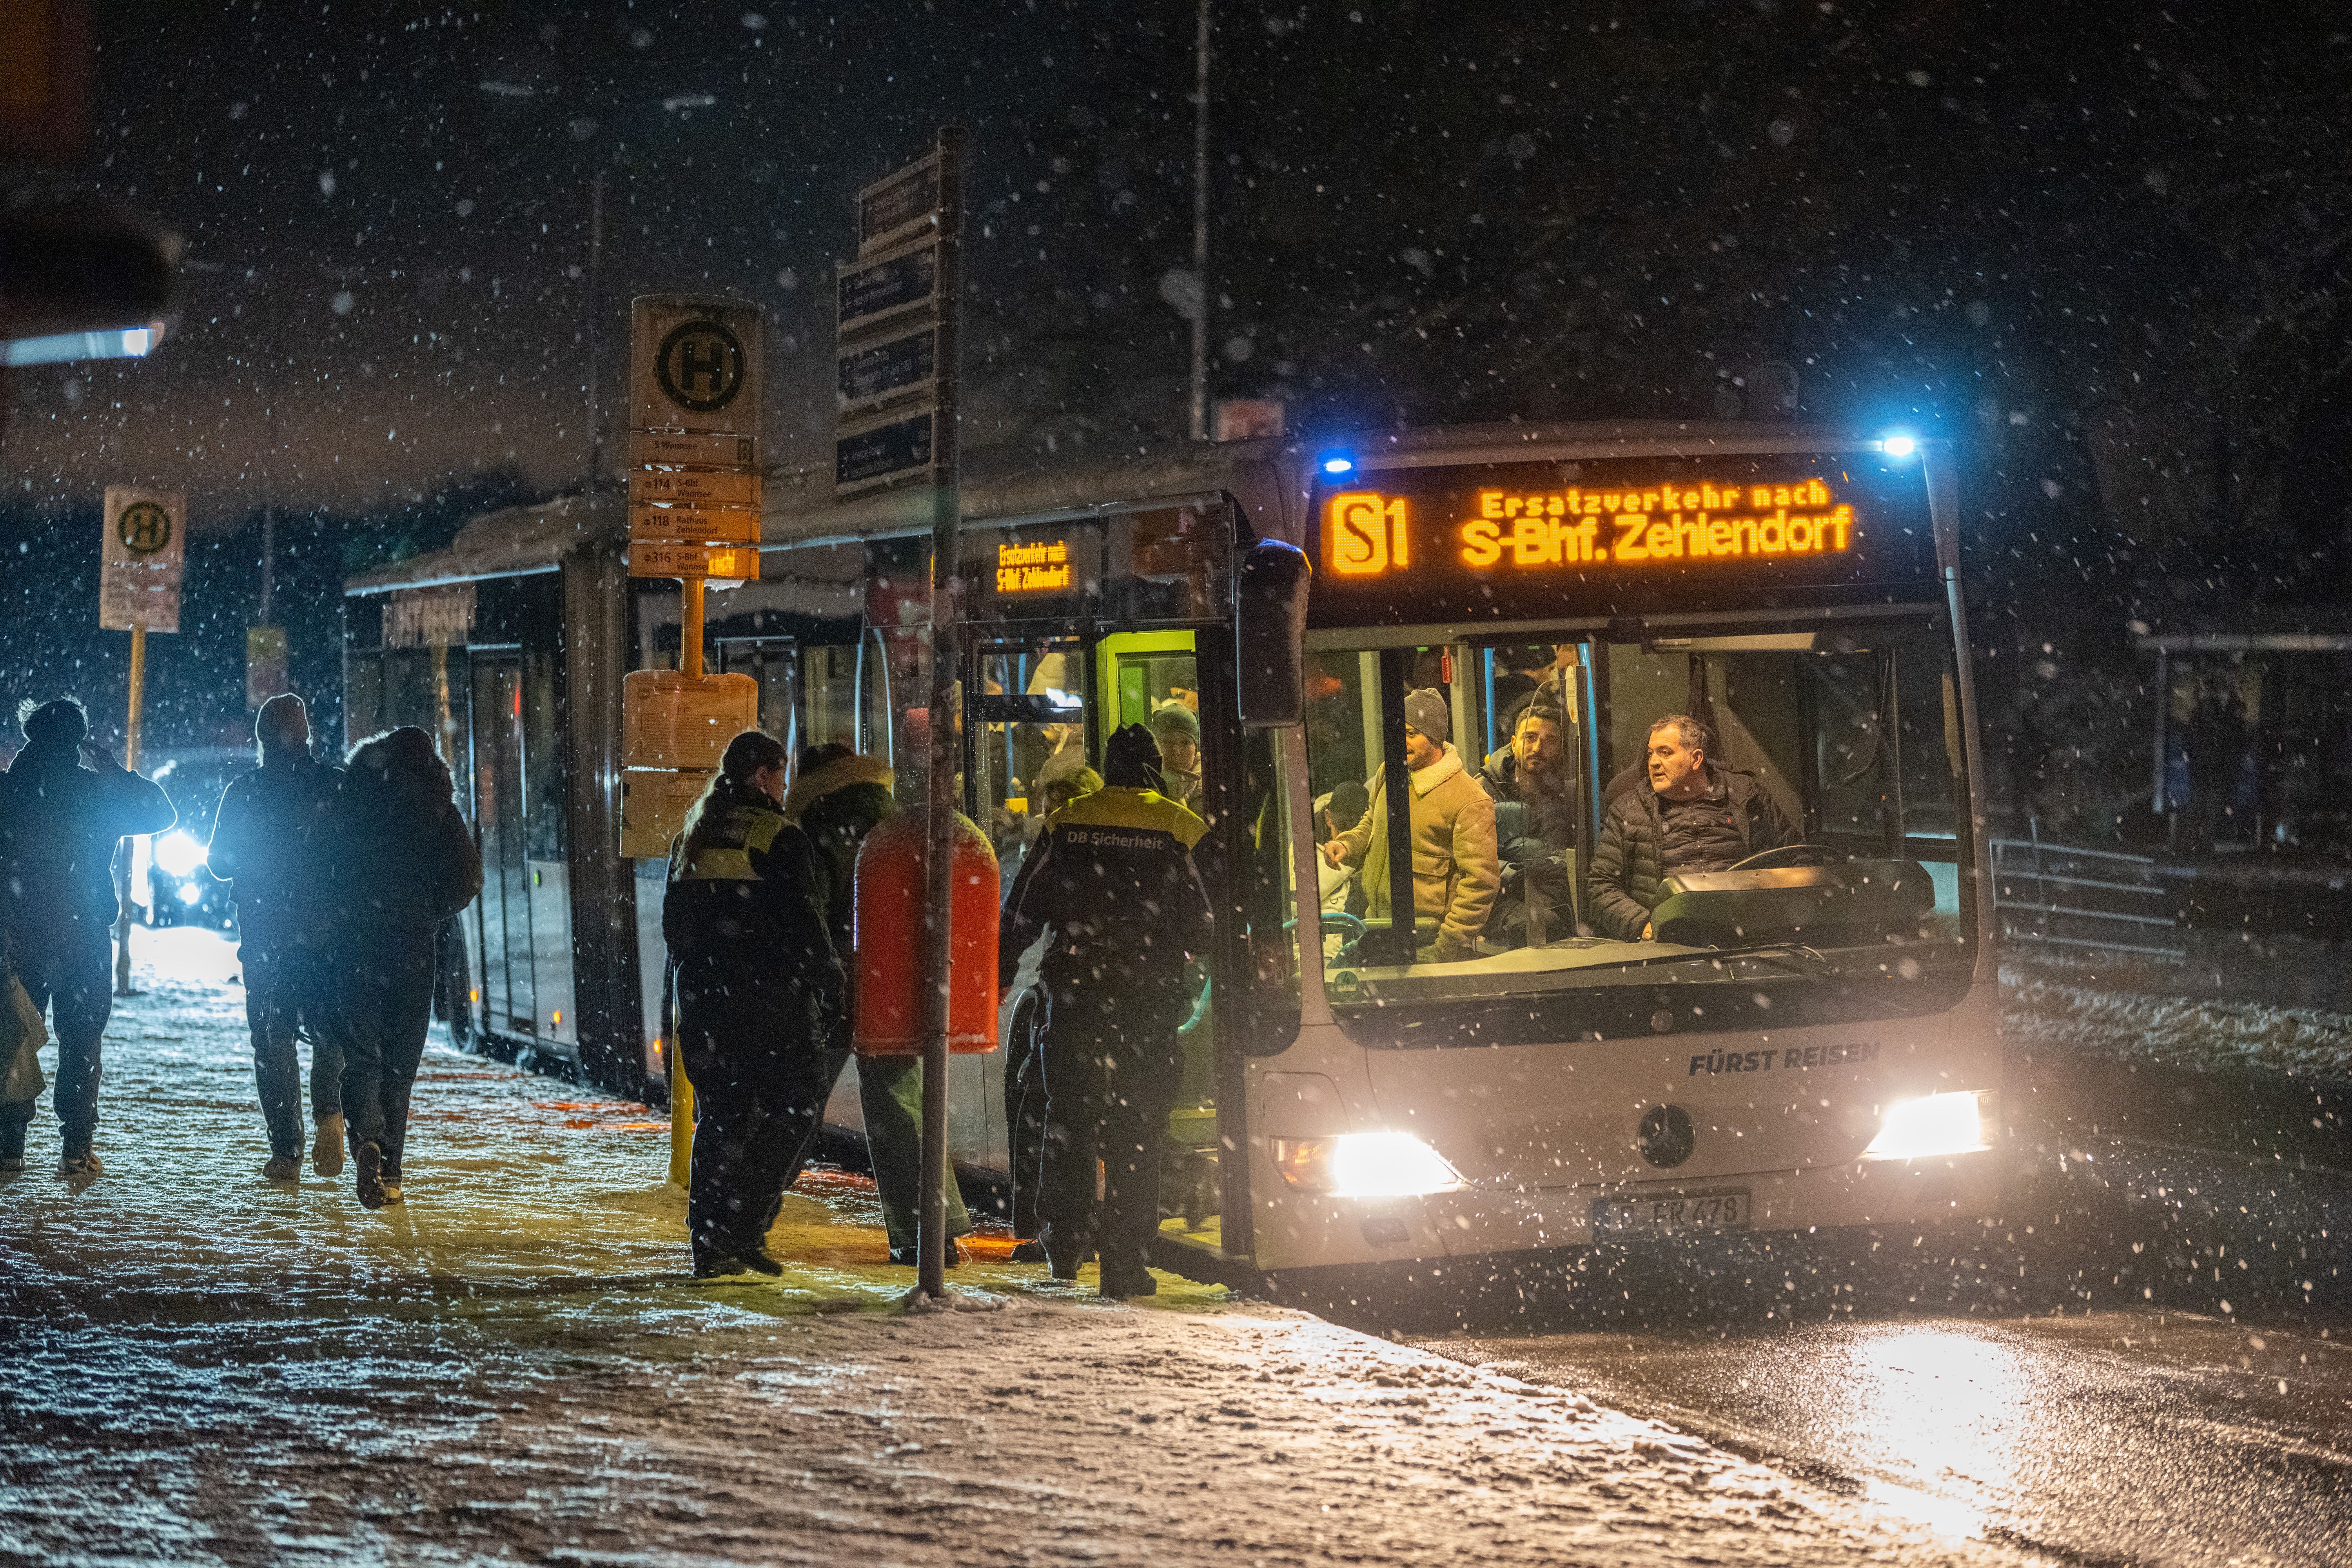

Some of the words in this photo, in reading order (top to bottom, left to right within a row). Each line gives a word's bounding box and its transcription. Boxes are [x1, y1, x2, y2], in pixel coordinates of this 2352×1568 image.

[682, 341, 722, 391] H
[662, 441, 697, 450] Wannsee
[653, 479, 670, 489] 114
[677, 489, 712, 498] Wannsee
[1483, 485, 1739, 517] Ersatzverkehr
[1754, 481, 1827, 506] nach
[652, 515, 669, 526] 118
[676, 526, 718, 535] Zehlendorf
[1333, 495, 1408, 573] S1
[1463, 517, 1607, 564] S-Bhf.
[1615, 507, 1850, 559] Zehlendorf
[652, 552, 670, 563] 316
[1067, 831, 1088, 843] DB
[1091, 831, 1163, 850] Sicherheit
[1689, 1049, 1777, 1076] FÜRST
[1784, 1042, 1880, 1069] REISEN
[1654, 1202, 1684, 1226] FR
[1693, 1198, 1737, 1224] 478
